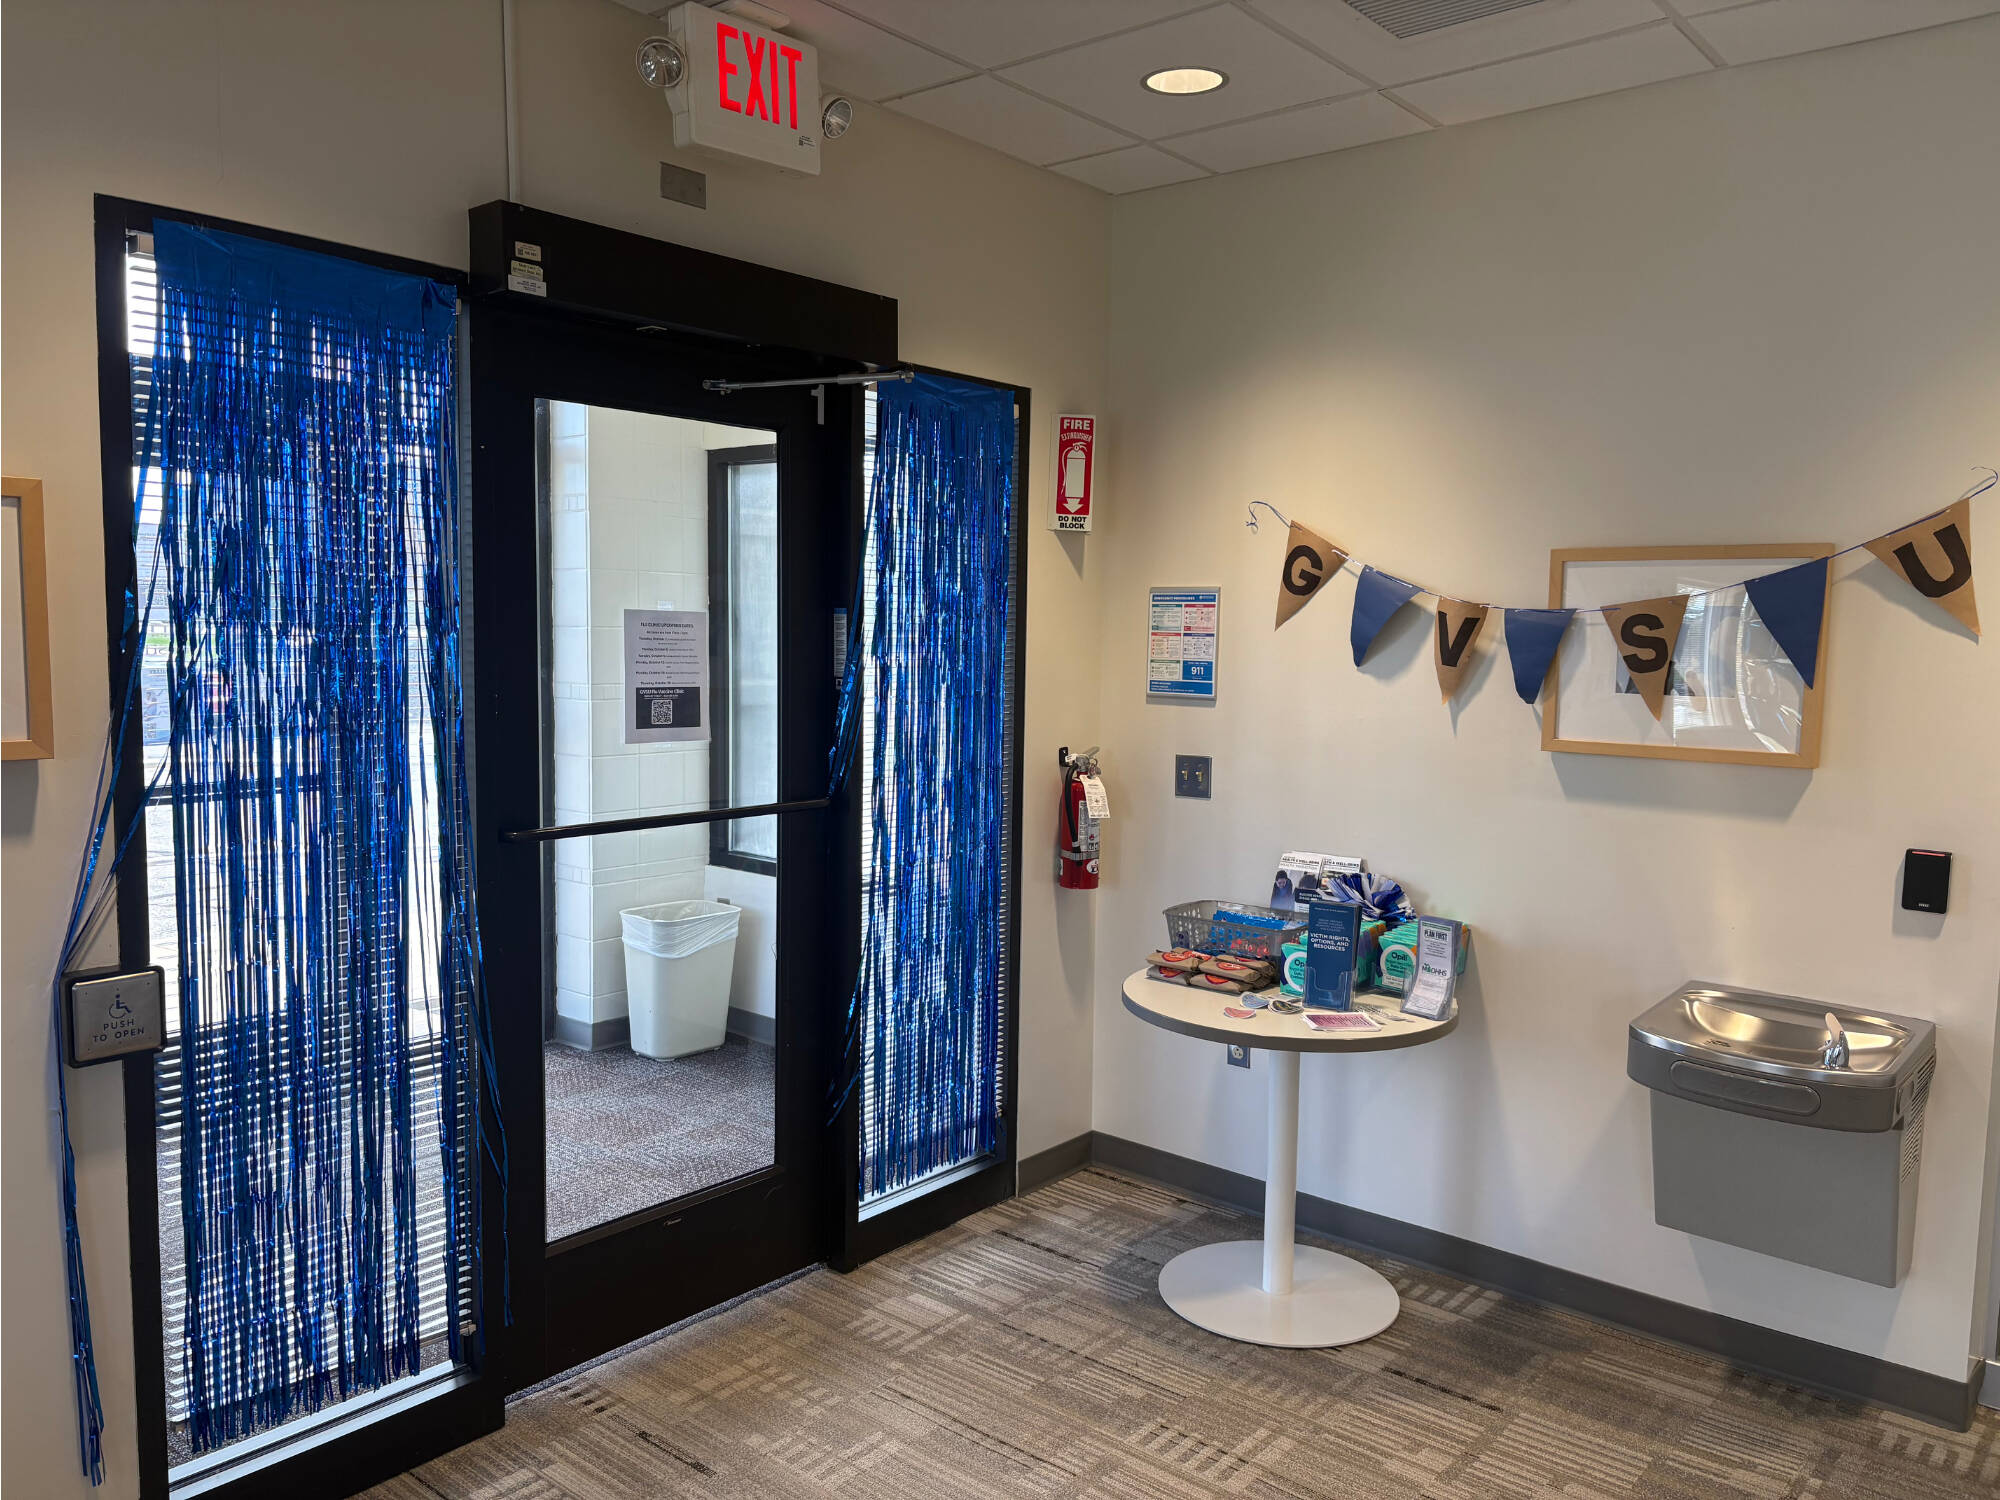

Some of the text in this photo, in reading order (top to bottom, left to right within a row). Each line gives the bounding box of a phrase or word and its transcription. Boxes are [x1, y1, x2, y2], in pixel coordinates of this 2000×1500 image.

[716, 22, 803, 130] EXIT
[1063, 419, 1090, 430] FIRE
[1059, 522, 1085, 530] BLOCK
[1281, 522, 1973, 674] G V S U
[1191, 666, 1204, 675] 911
[1424, 929, 1448, 941] PLAN FIRST
[1313, 943, 1346, 951] RESOURCES
[103, 1019, 134, 1031] PUSH
[93, 1027, 144, 1042] TO OPEN
